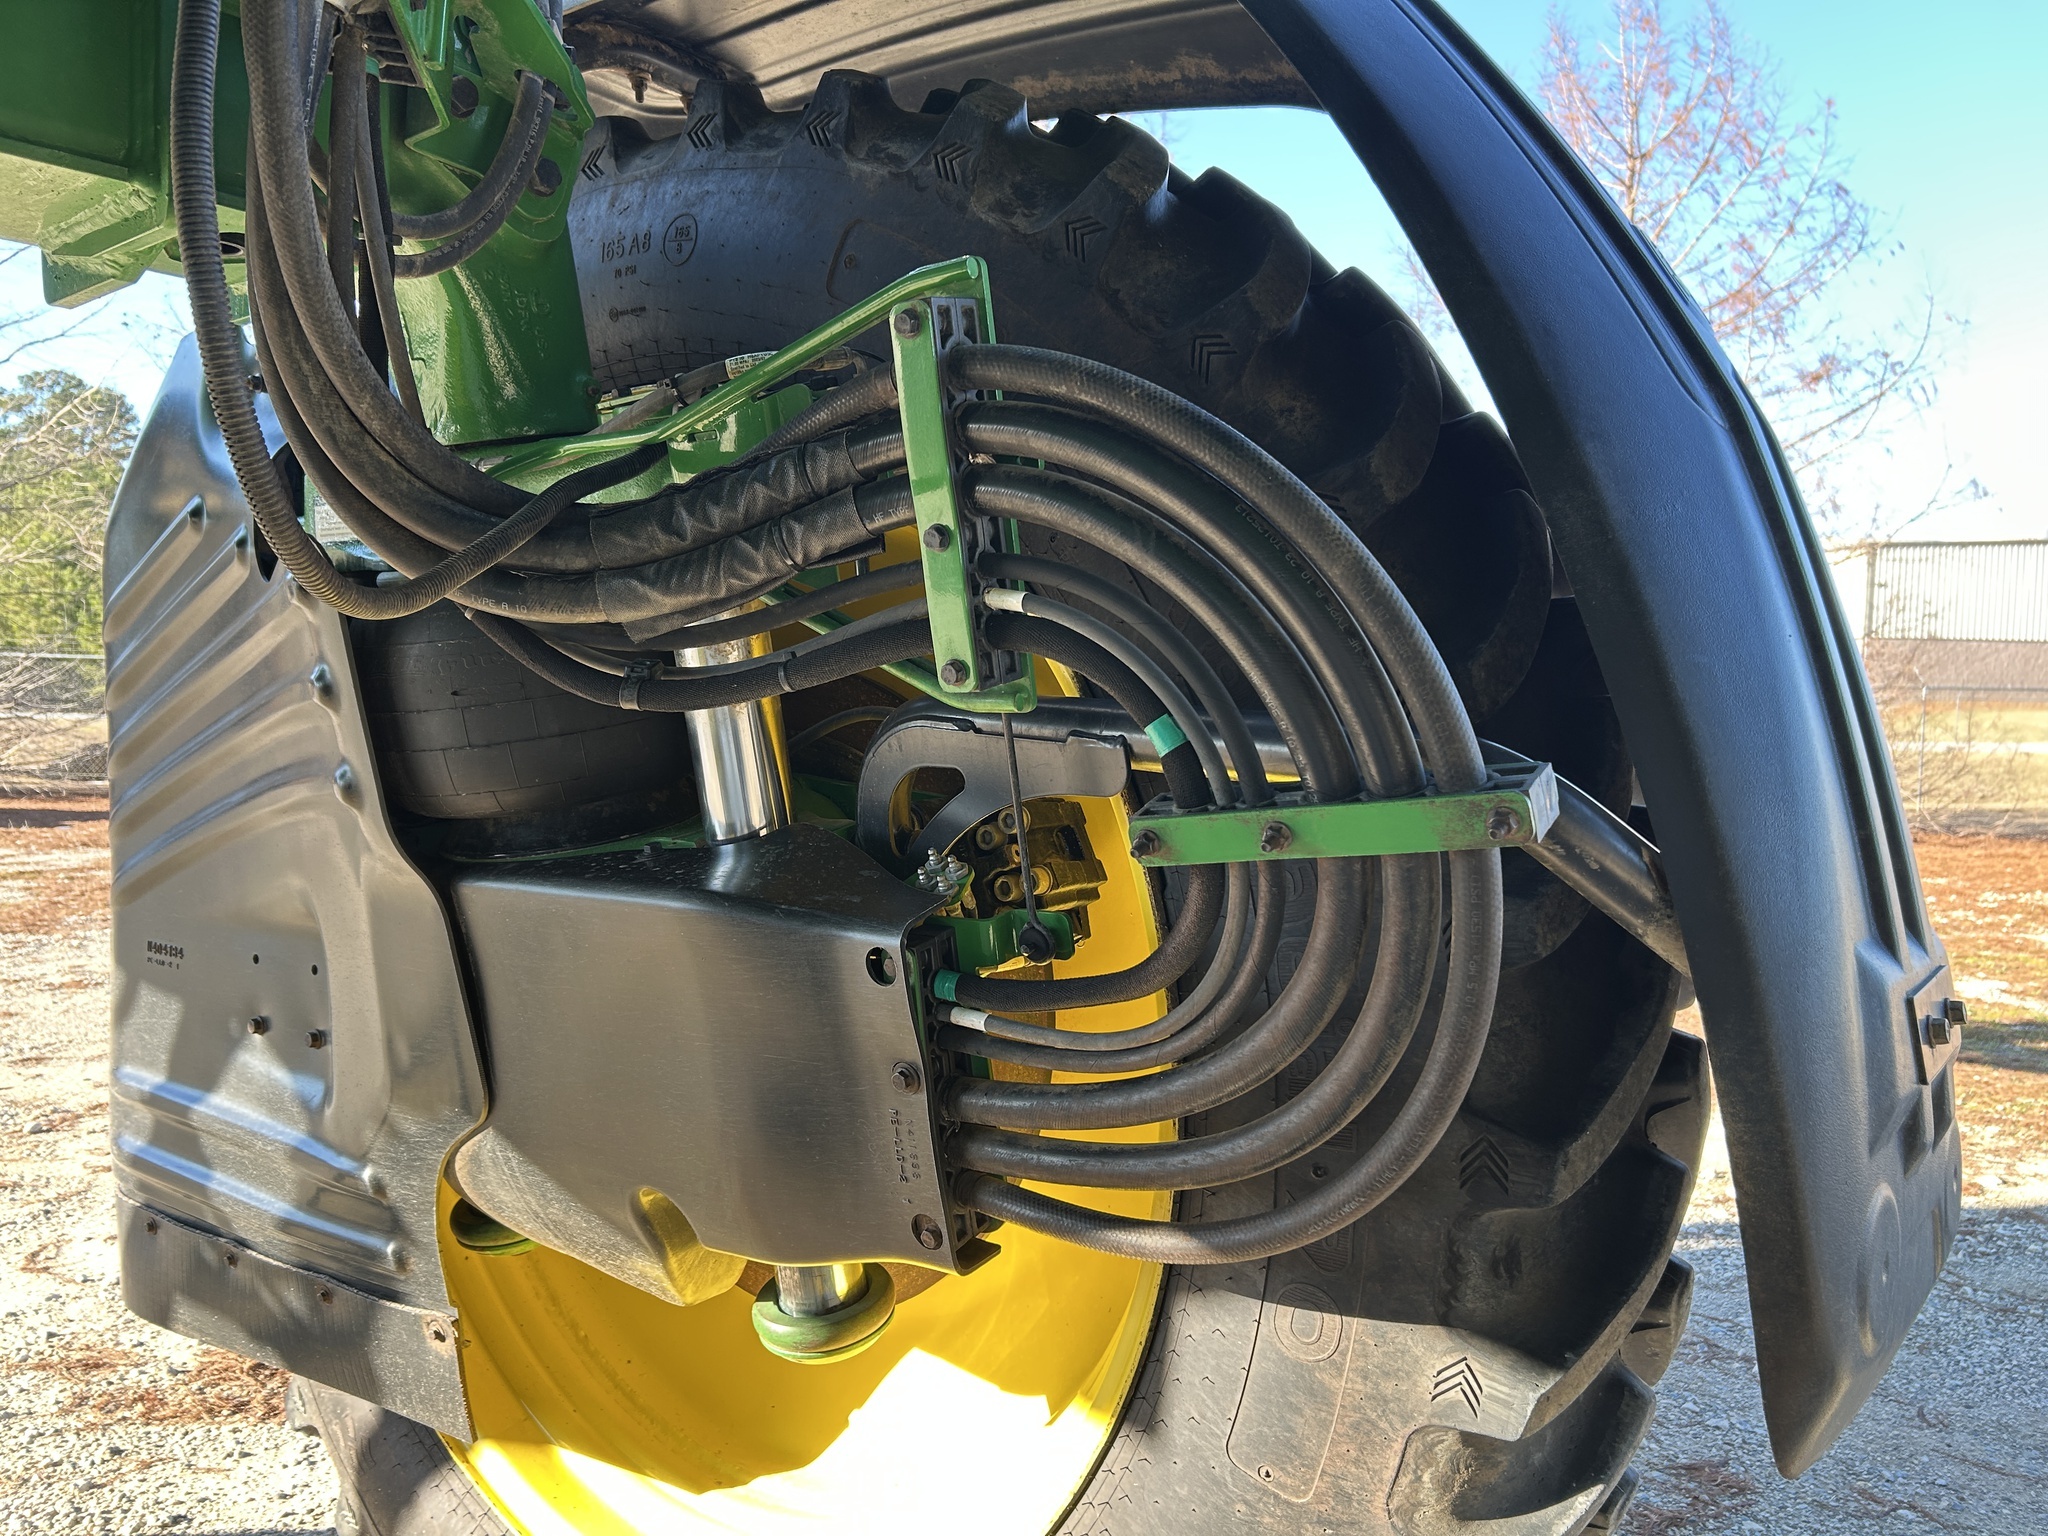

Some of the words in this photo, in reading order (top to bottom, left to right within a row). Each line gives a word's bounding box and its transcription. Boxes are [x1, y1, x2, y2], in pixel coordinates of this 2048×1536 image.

[872, 510, 885, 524] HF
[888, 504, 910, 519] TYPE
[1283, 550, 1300, 567] 23
[1299, 569, 1315, 585] 10
[469, 593, 496, 607] TYPE
[500, 601, 509, 610] A
[514, 604, 527, 613] 10
[1314, 587, 1326, 599] A
[1324, 601, 1350, 632] TYPE
[1372, 604, 1390, 622] IN
[1345, 633, 1364, 653] HF
[1386, 624, 1413, 660] MADE
[1260, 689, 1279, 718] TYPE
